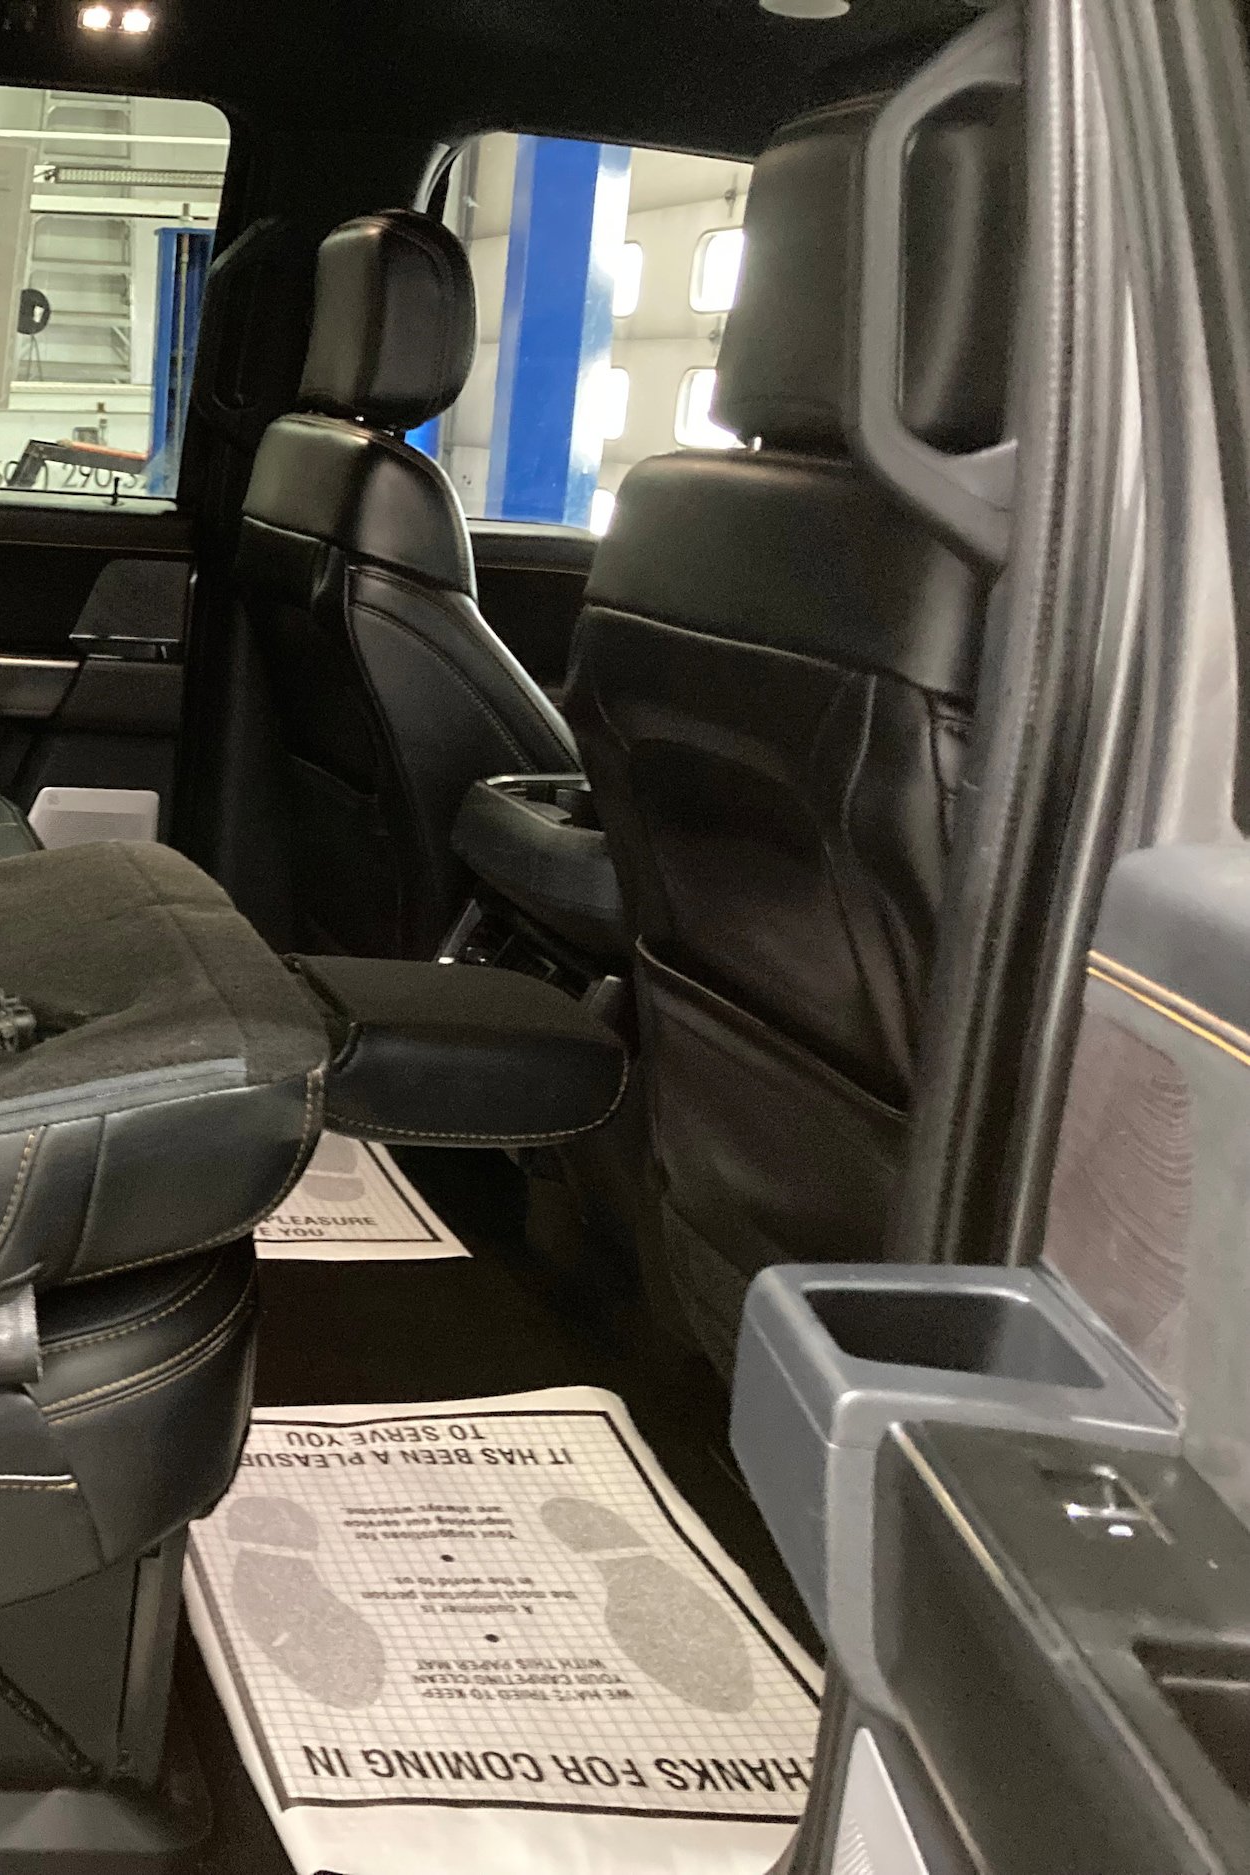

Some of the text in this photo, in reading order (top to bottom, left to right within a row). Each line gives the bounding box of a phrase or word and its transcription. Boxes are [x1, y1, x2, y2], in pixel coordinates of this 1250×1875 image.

[285, 1423, 485, 1448] TO SERVE YOU
[369, 1450, 390, 1466] A
[401, 1448, 473, 1465] BEEN
[480, 1448, 539, 1465] HAS
[546, 1448, 574, 1465] IT
[416, 1659, 606, 1671] WITH THIS PAPER MAT
[412, 1673, 625, 1685] YOUR CARPETING CLEAN
[421, 1688, 634, 1701] WE HAVE TRIED TO KEEP
[301, 1744, 813, 1793] HANKS FOR COMING IN
